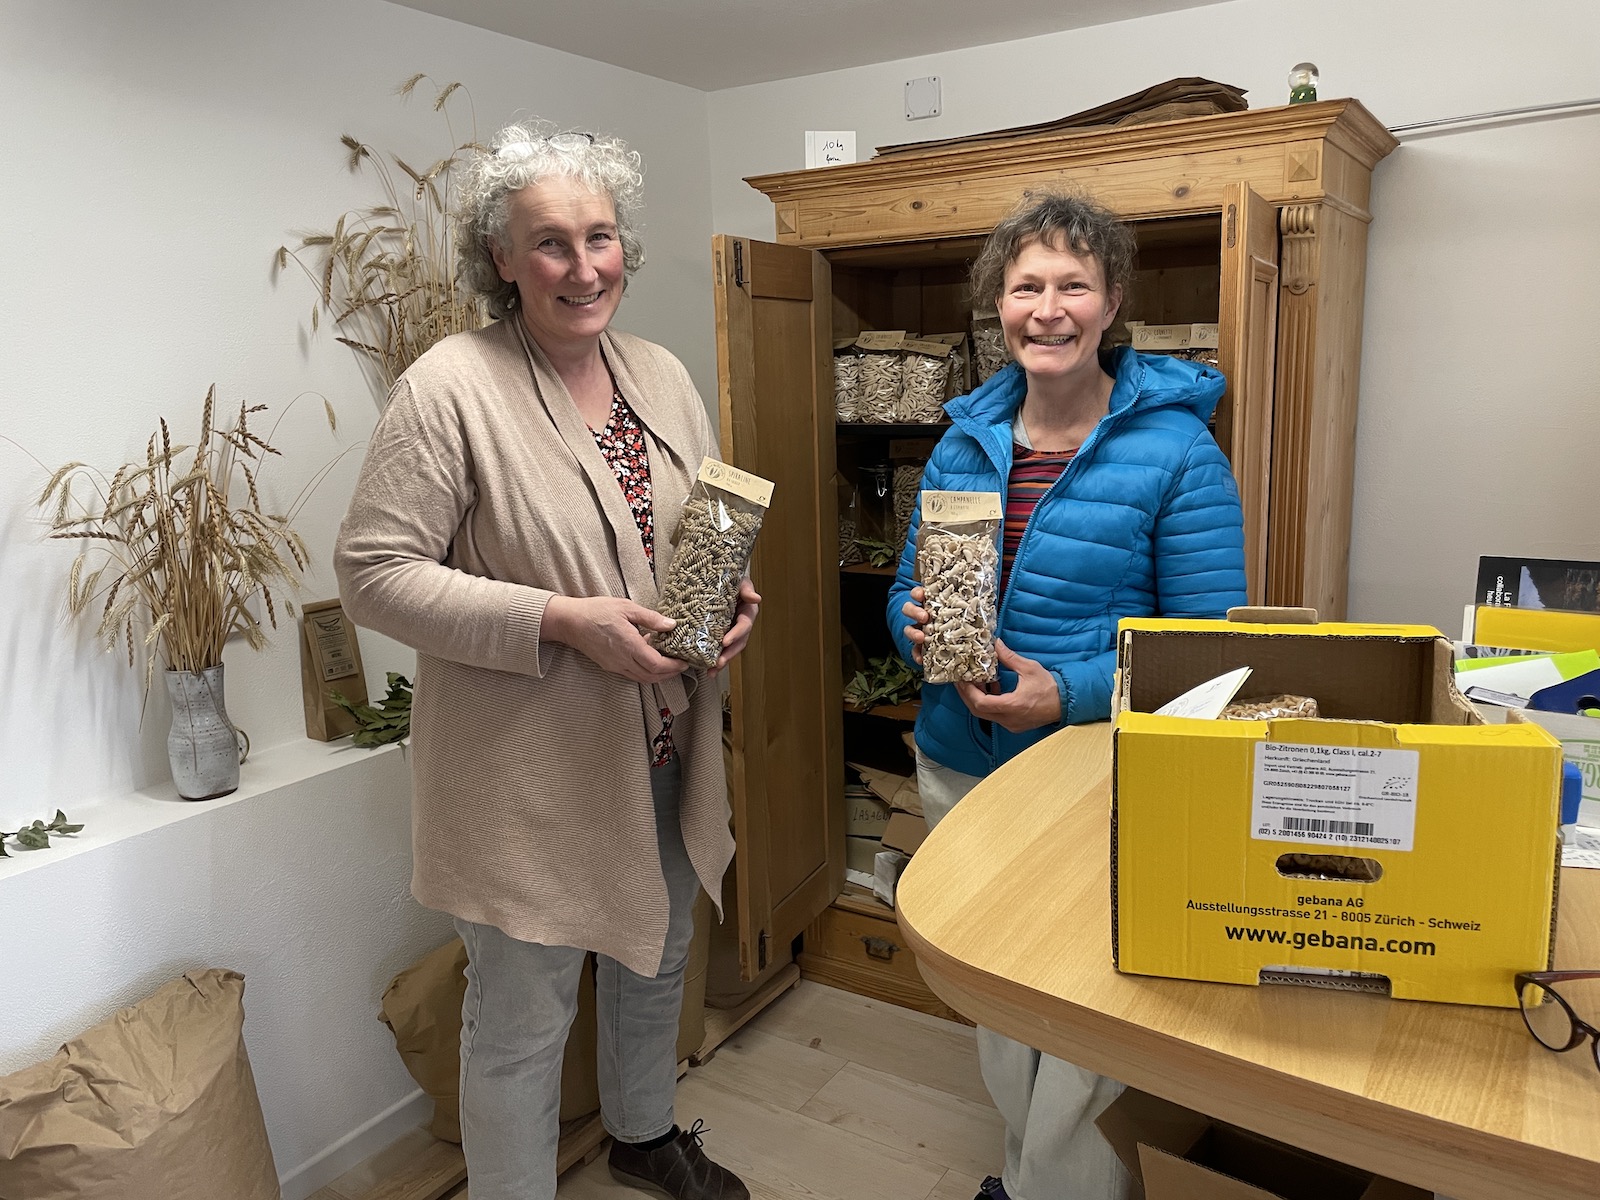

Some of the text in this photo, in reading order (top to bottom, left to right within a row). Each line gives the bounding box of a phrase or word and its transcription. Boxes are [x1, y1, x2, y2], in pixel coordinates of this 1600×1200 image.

[823, 141, 835, 151] 10
[950, 496, 982, 505] CAMPANELLE
[1503, 592, 1513, 601] La
[1265, 743, 1309, 754] Bio-Zitronen
[1332, 748, 1350, 756] Class
[1335, 834, 1348, 842] (10)
[1297, 895, 1364, 908] gebana AG
[1186, 899, 1311, 919] Ausstellungsstrasse
[1314, 909, 1327, 920] 21
[1341, 911, 1371, 923] 8005
[1374, 914, 1415, 927] Zürich
[1428, 918, 1481, 931] Schweiz
[1225, 925, 1436, 956] www.gebana.com
